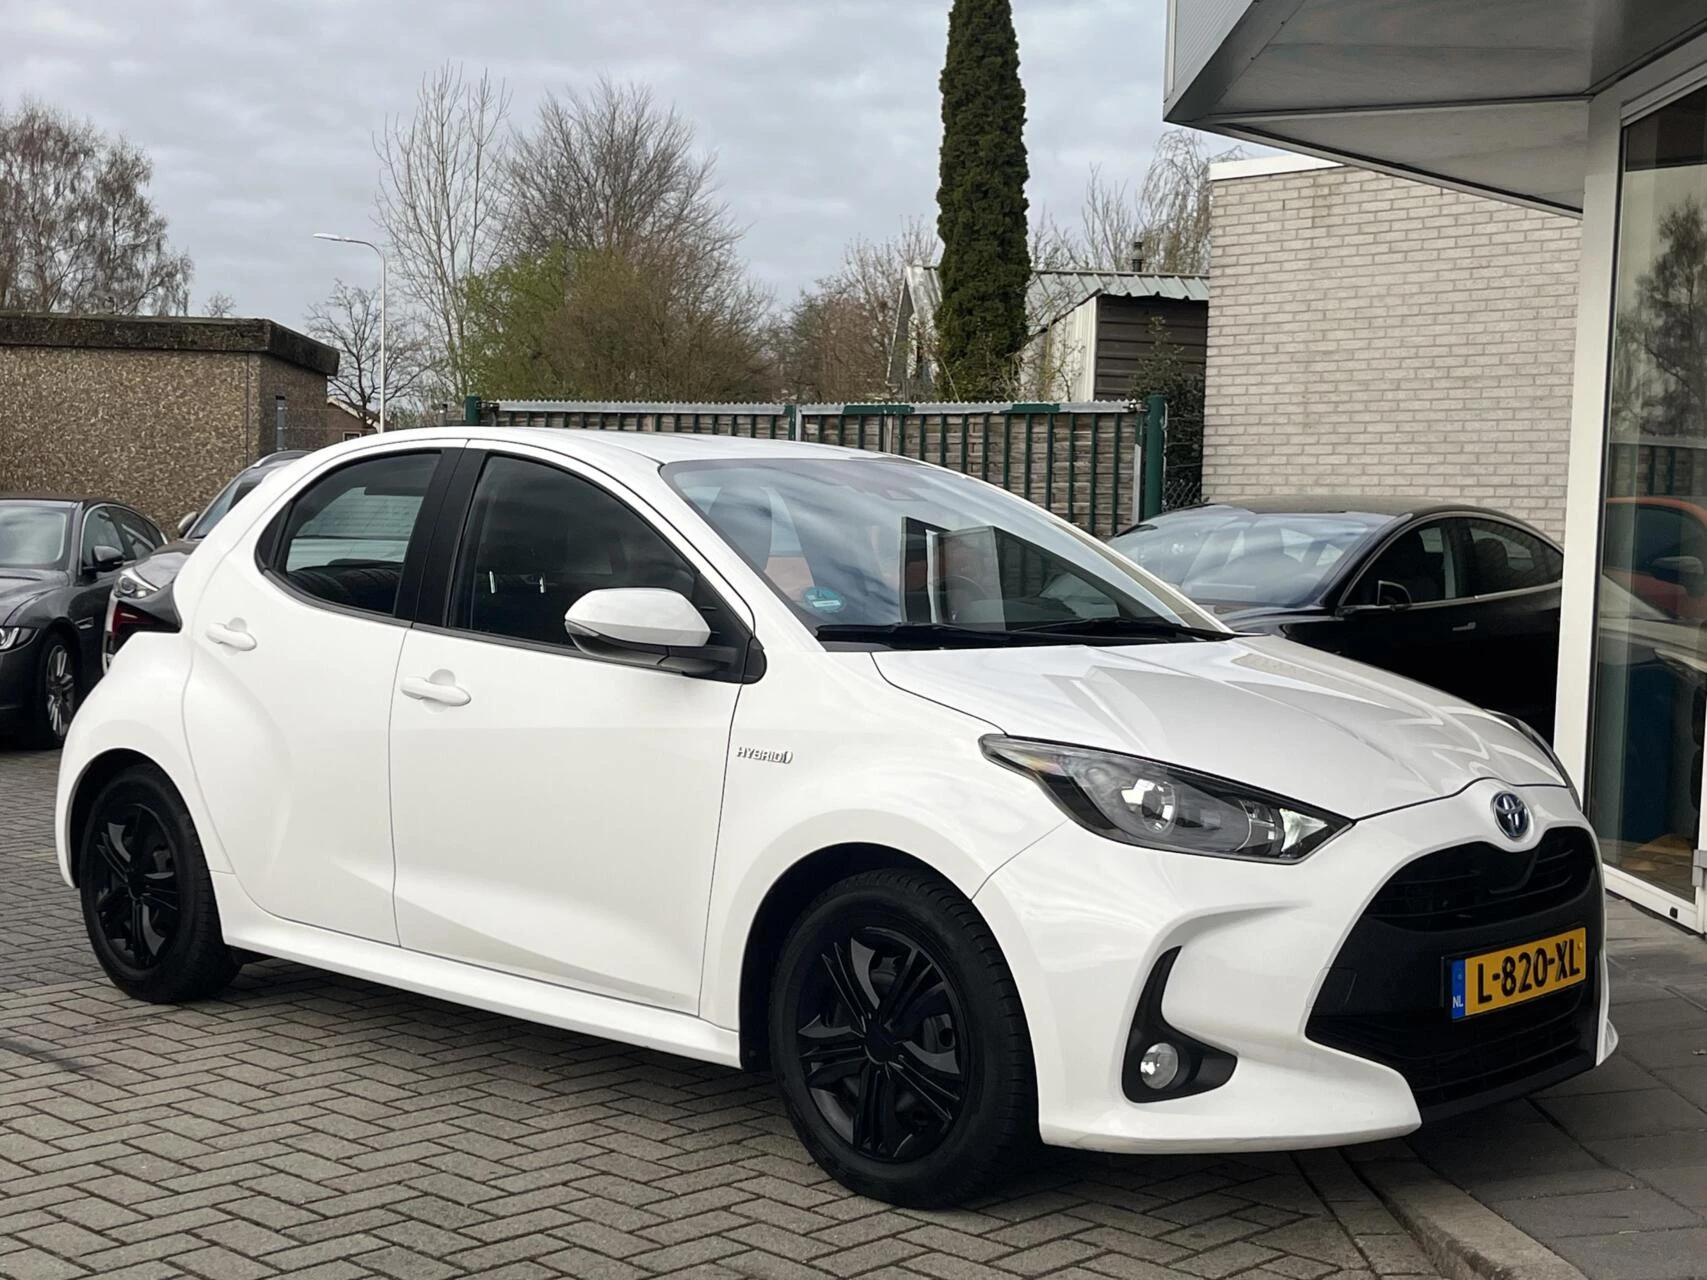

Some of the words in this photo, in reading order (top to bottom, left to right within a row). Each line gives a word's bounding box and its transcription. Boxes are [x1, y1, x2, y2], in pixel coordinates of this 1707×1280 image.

[737, 747, 784, 763] HYBRID
[1477, 938, 1580, 1005] L-820-XL
[1452, 995, 1464, 1009] NL
